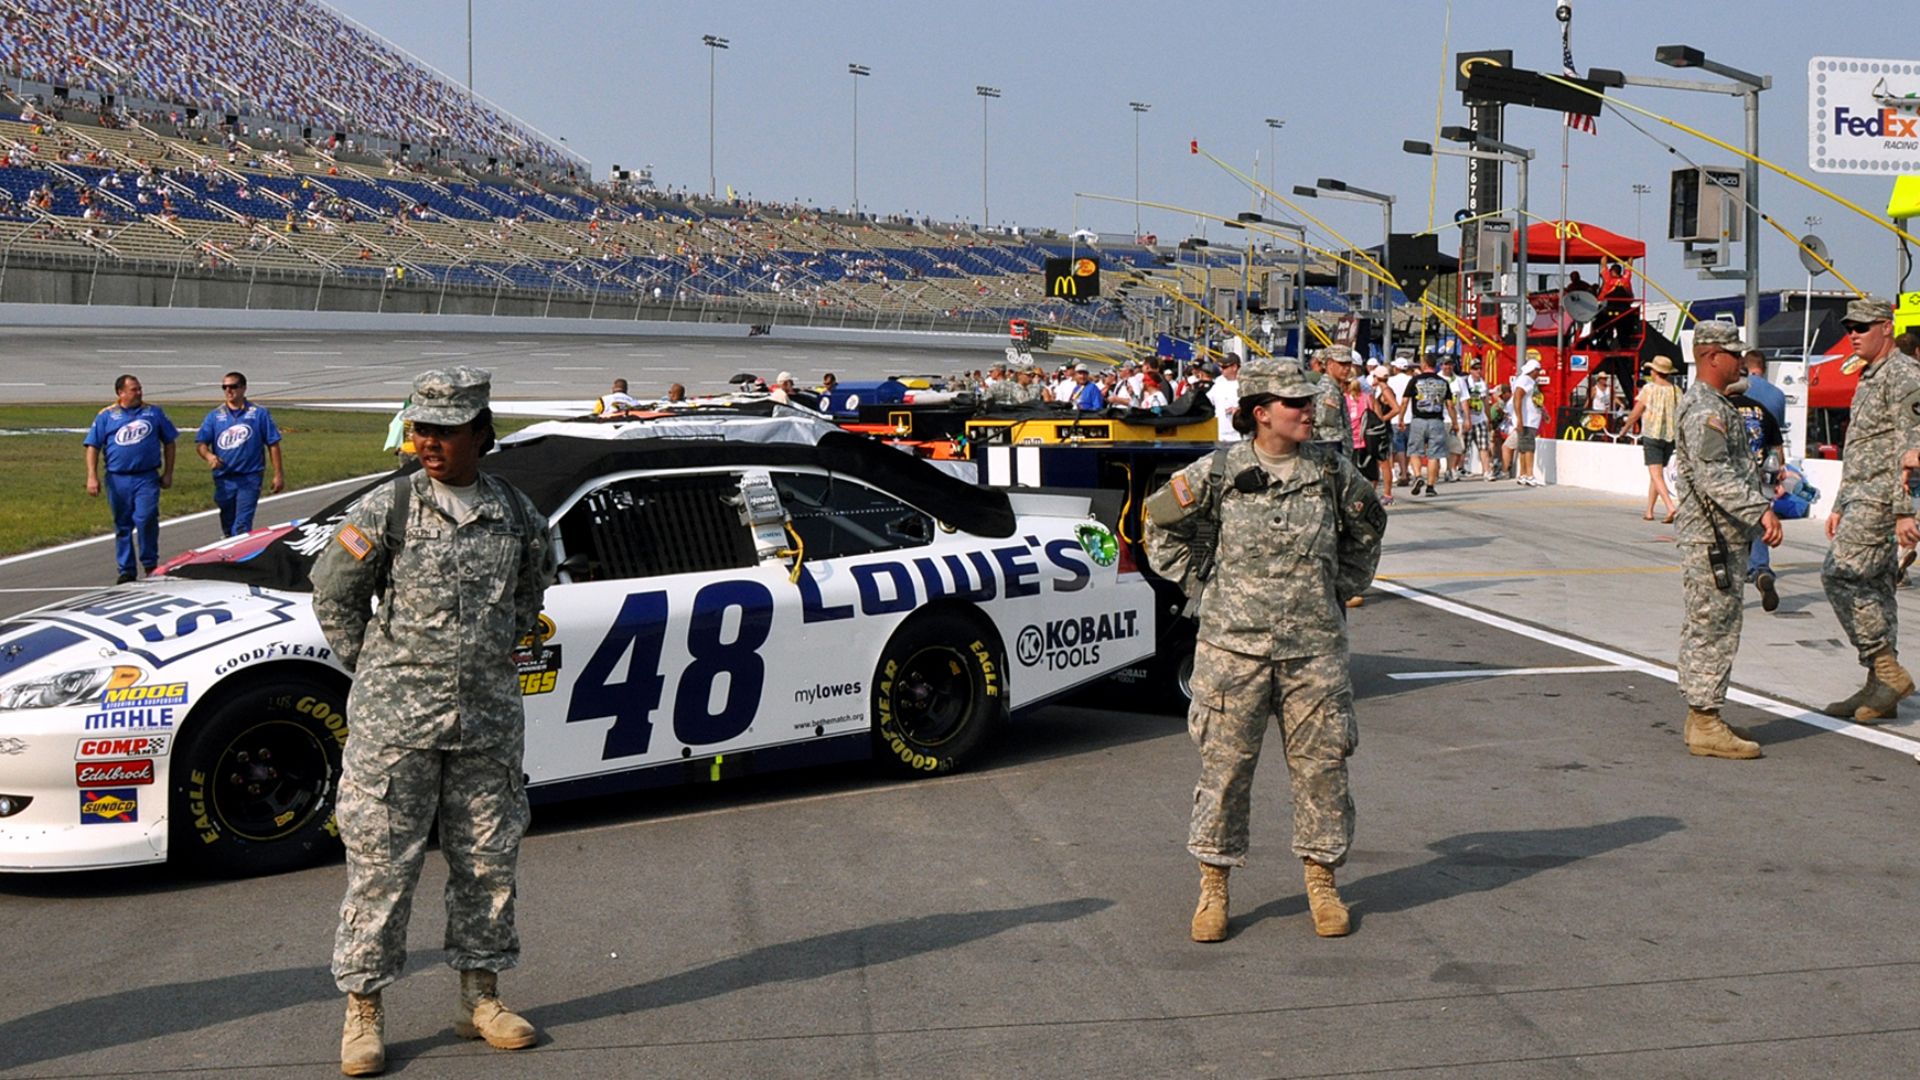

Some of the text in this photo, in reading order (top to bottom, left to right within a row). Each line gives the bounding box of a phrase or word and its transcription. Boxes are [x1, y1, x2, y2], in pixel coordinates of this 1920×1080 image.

[1834, 106, 1918, 137] FedEx
[1883, 140, 1919, 150] RACING
[785, 536, 1091, 624] LOWE'S
[1046, 610, 1137, 650] KOBALT
[215, 642, 331, 675] GOODYEAR
[566, 580, 774, 760] 48
[970, 640, 998, 697] EAGLE
[1045, 645, 1100, 671] TOOLS
[104, 684, 186, 703] MOOG
[518, 670, 558, 695] EGS
[795, 682, 862, 704] mylowes
[85, 708, 174, 729] MAHLE
[81, 739, 149, 755] COMP
[79, 764, 150, 782] Edelbrock
[84, 800, 134, 812] SUNOCO
[189, 769, 220, 844] EAGLE
